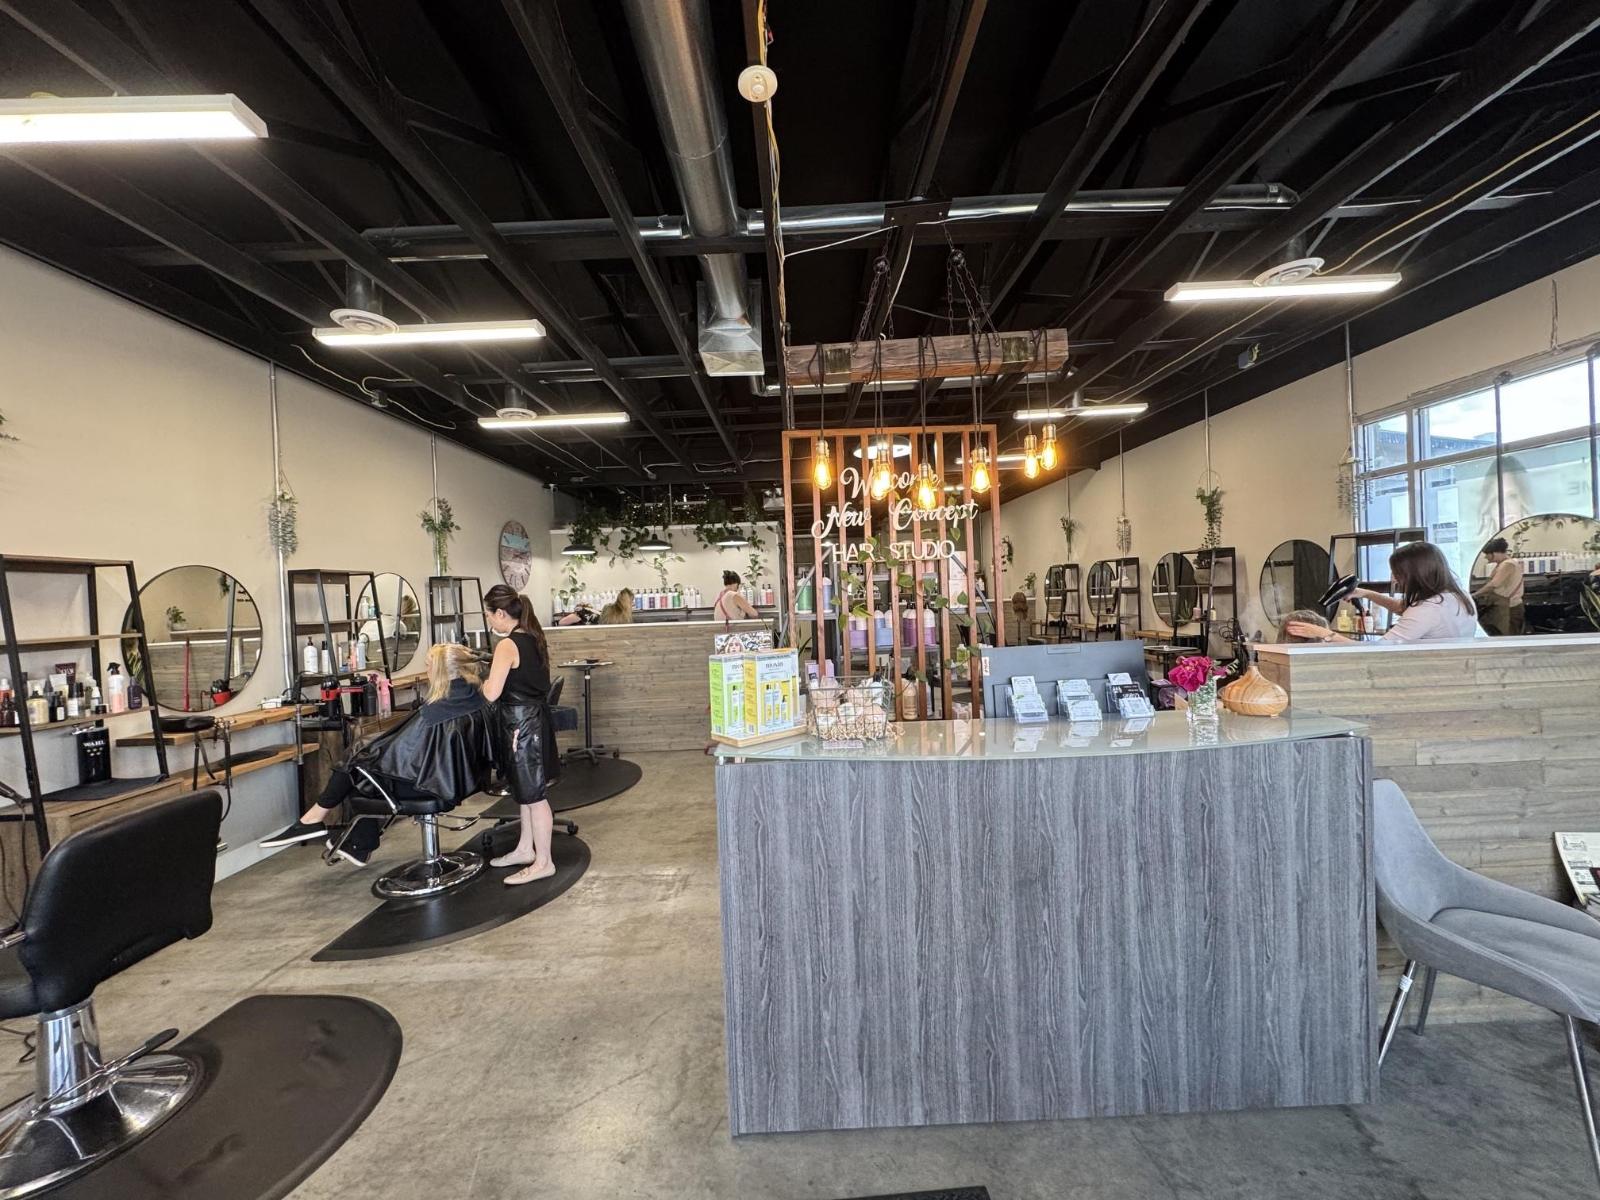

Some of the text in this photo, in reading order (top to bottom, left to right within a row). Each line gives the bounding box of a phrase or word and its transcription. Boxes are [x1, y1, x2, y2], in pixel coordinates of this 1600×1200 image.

[811, 498, 979, 539] New Concept
[889, 540, 955, 560] STUDIO
